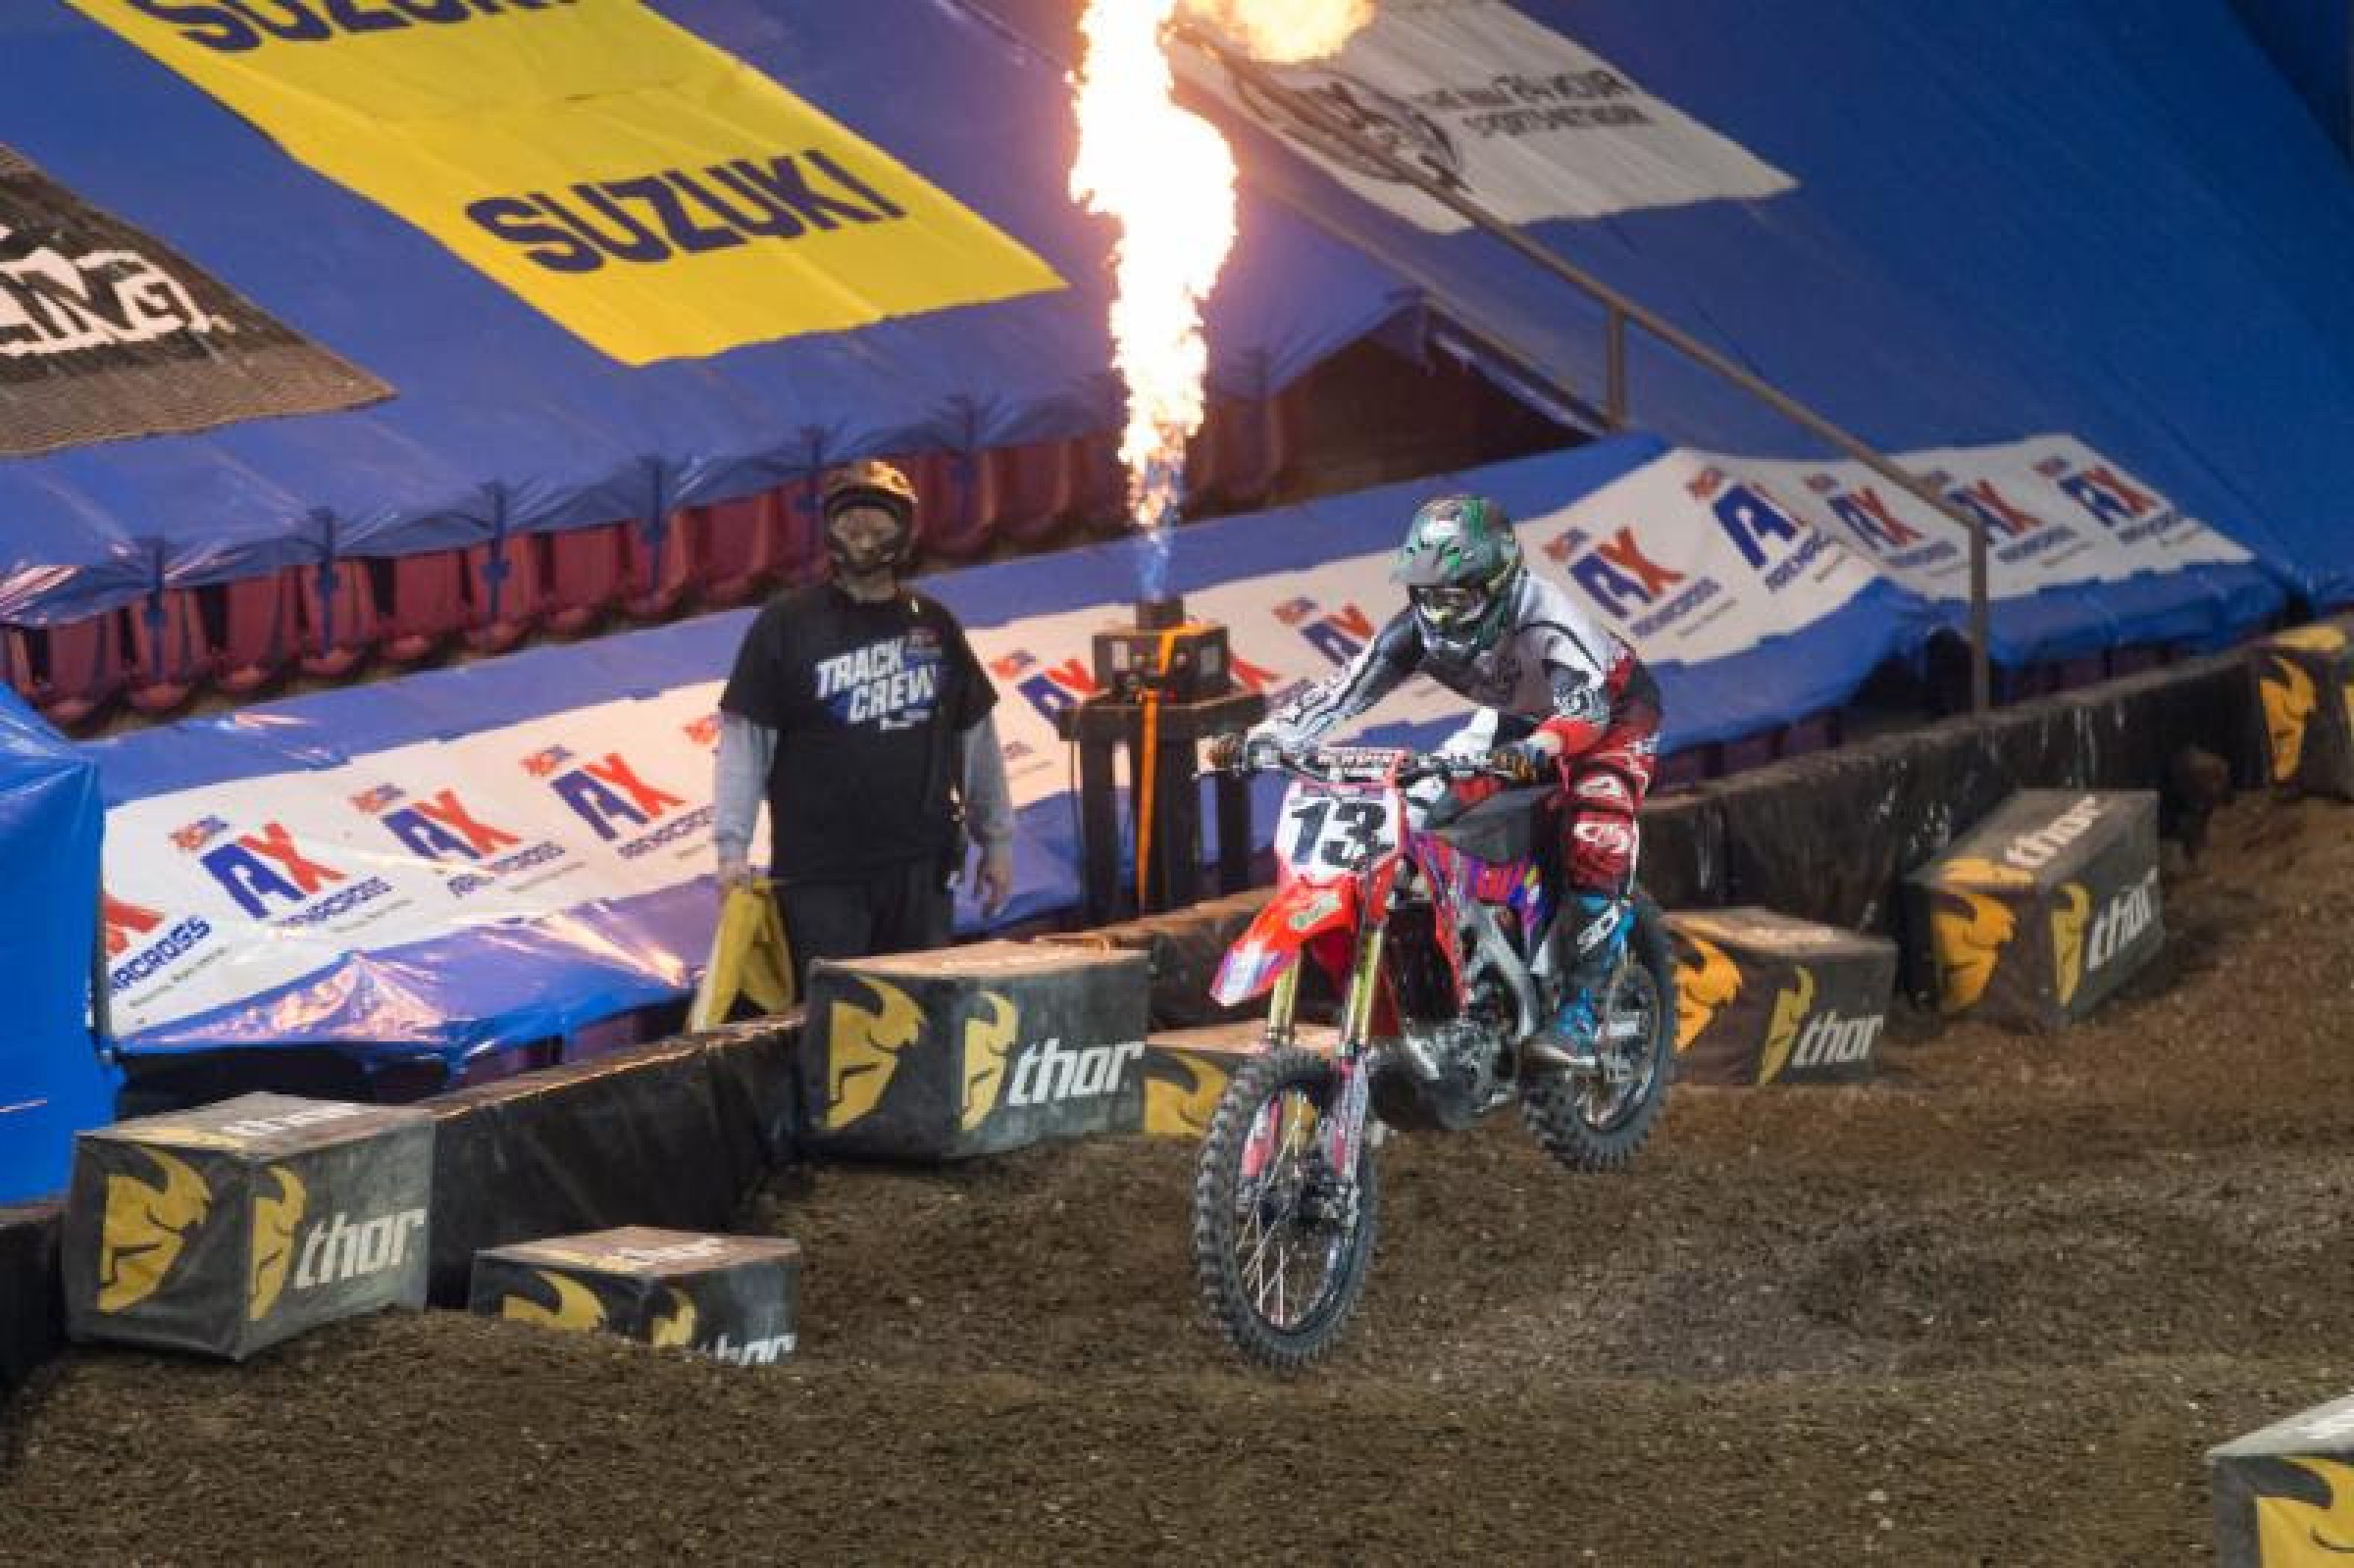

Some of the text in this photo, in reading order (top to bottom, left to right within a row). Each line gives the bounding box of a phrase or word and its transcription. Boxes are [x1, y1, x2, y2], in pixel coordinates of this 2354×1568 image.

[465, 149, 906, 273] SUZUKI
[2057, 465, 2159, 528] AX
[1568, 527, 1686, 622] AX
[816, 637, 904, 700] TRACK
[848, 663, 936, 724] CREW
[381, 788, 522, 860] AX
[548, 753, 687, 841] AX
[199, 822, 348, 920] AX
[1290, 802, 1396, 871] 13
[2087, 865, 2158, 971] thor
[1008, 1037, 1146, 1107] thor
[1791, 1012, 1884, 1068] thor
[296, 1208, 426, 1290] thor
